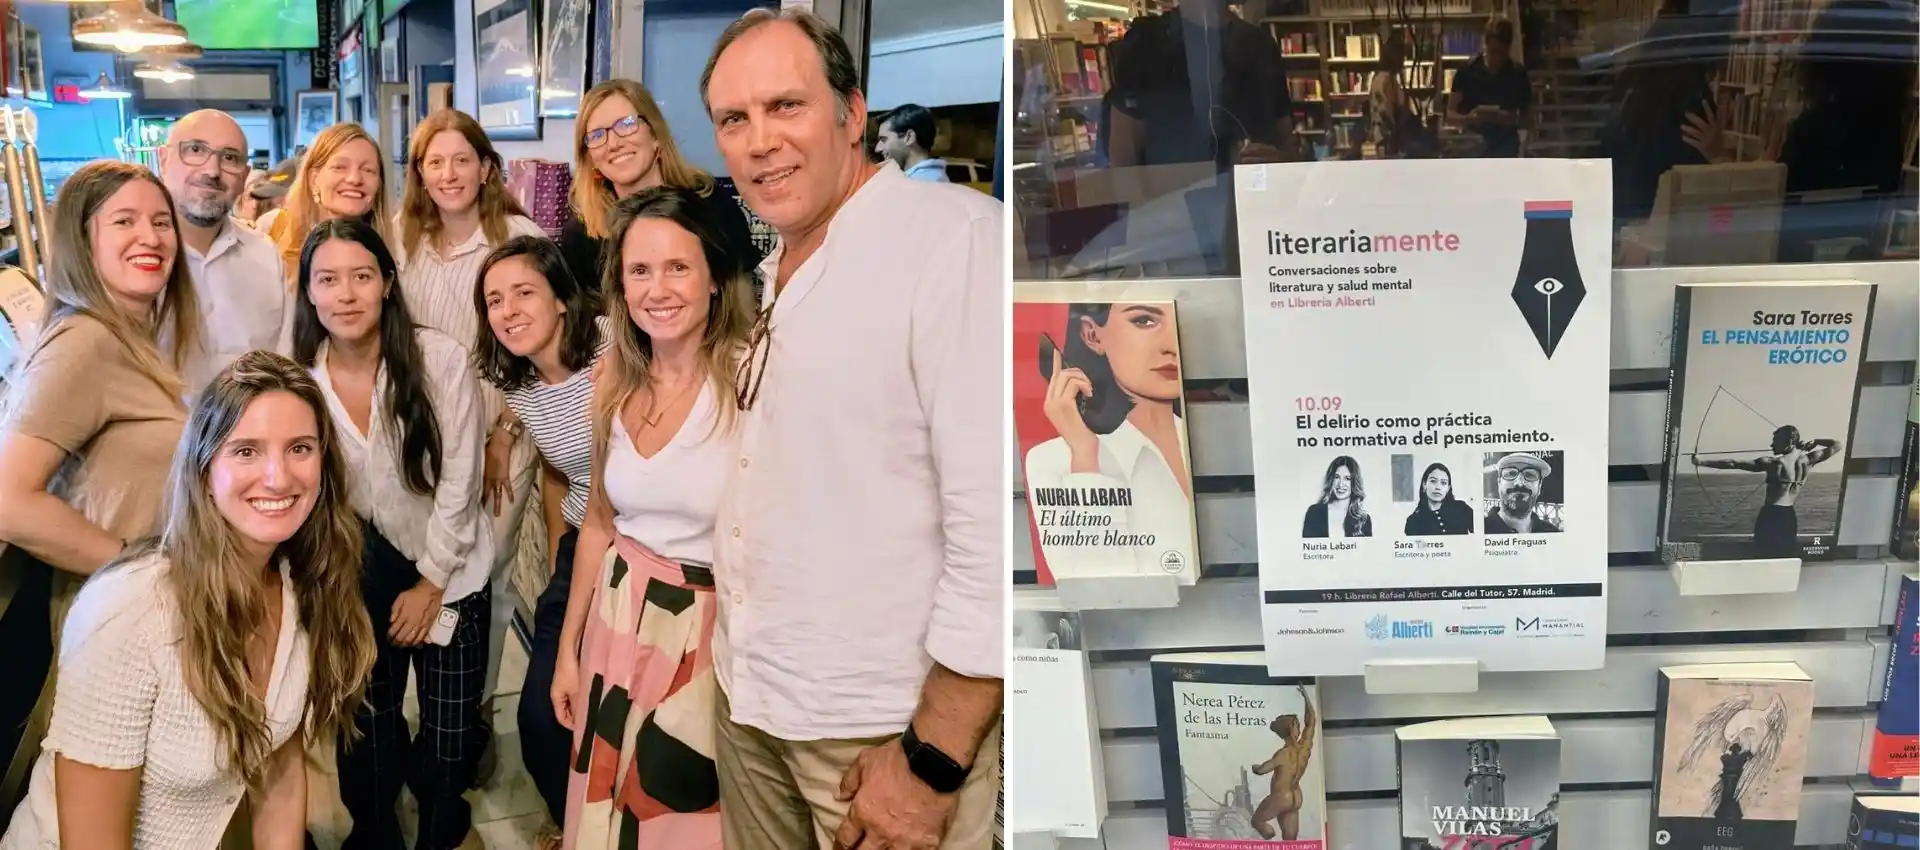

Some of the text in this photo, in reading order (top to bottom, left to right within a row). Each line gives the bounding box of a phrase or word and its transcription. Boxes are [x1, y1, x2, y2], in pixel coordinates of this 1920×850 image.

[1267, 229, 1460, 255] literariamente
[1268, 263, 1397, 276] Conversaciones sobre
[1269, 279, 1412, 294] literatura y salud mental
[1270, 300, 1285, 309] en
[1335, 296, 1376, 307] Alberti
[1753, 310, 1853, 326] Sara Torres
[1702, 330, 1850, 345] EL PENSAMIENTO
[1768, 345, 1848, 365] ERÓTICO
[1295, 397, 1342, 411] 10.09
[1296, 412, 1492, 431] El delirio como práctica
[1297, 429, 1555, 448] no normativa del pensamiento.
[1036, 488, 1132, 506] NURIA LABARI
[1040, 510, 1111, 527] El último
[1042, 530, 1156, 546] hombre blanco
[1302, 541, 1357, 551] Nuria Labari
[1394, 540, 1444, 549] Sara Trres
[1484, 537, 1547, 548] David Fraguas
[1379, 591, 1405, 599] Rafael
[1441, 589, 1462, 598] Calle
[1464, 589, 1478, 597] del
[1480, 589, 1505, 598] Tutor,
[1507, 588, 1521, 597] 57.
[1523, 587, 1556, 596] Madrid.
[1392, 620, 1433, 639] Alberti
[1182, 692, 1266, 710] Nerea Pérez
[1184, 710, 1267, 726] de las Heras
[1185, 728, 1230, 741] Fantasma
[1432, 805, 1535, 821] MANUEL
[1431, 820, 1501, 836] VILAS
